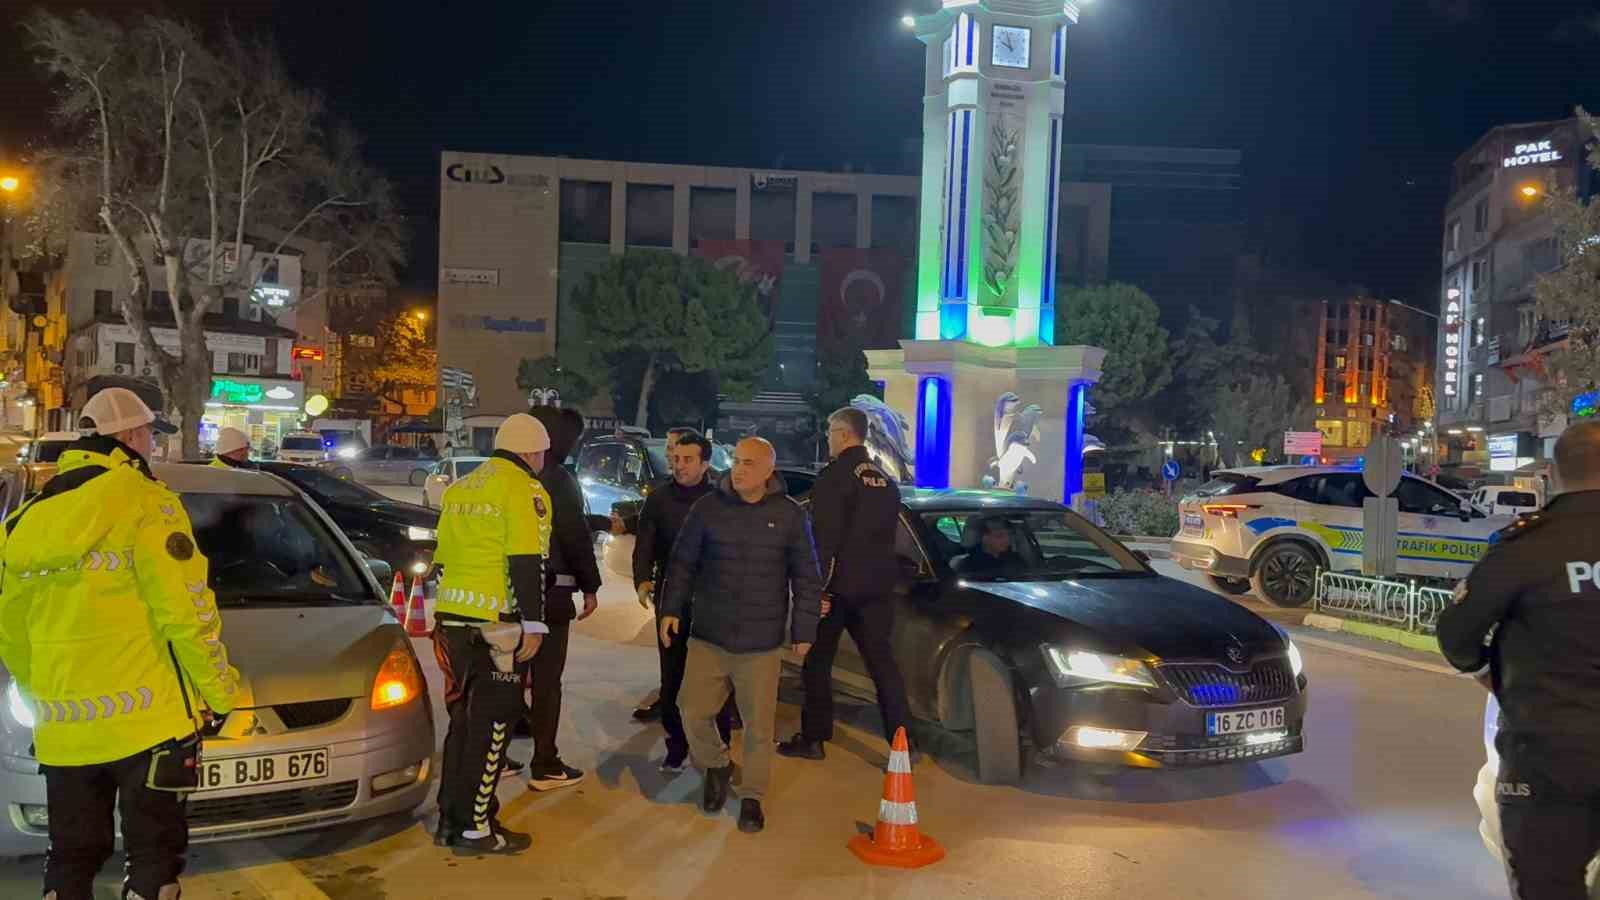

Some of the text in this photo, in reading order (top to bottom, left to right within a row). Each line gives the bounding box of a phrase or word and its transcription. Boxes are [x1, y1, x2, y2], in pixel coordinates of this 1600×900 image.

[1503, 150, 1563, 168] HOTEL
[1514, 140, 1552, 156] PAK
[1444, 333, 1459, 395] HOTEL
[1217, 709, 1282, 733] 16 ZC 016
[199, 752, 325, 788] 16 BJB 676
